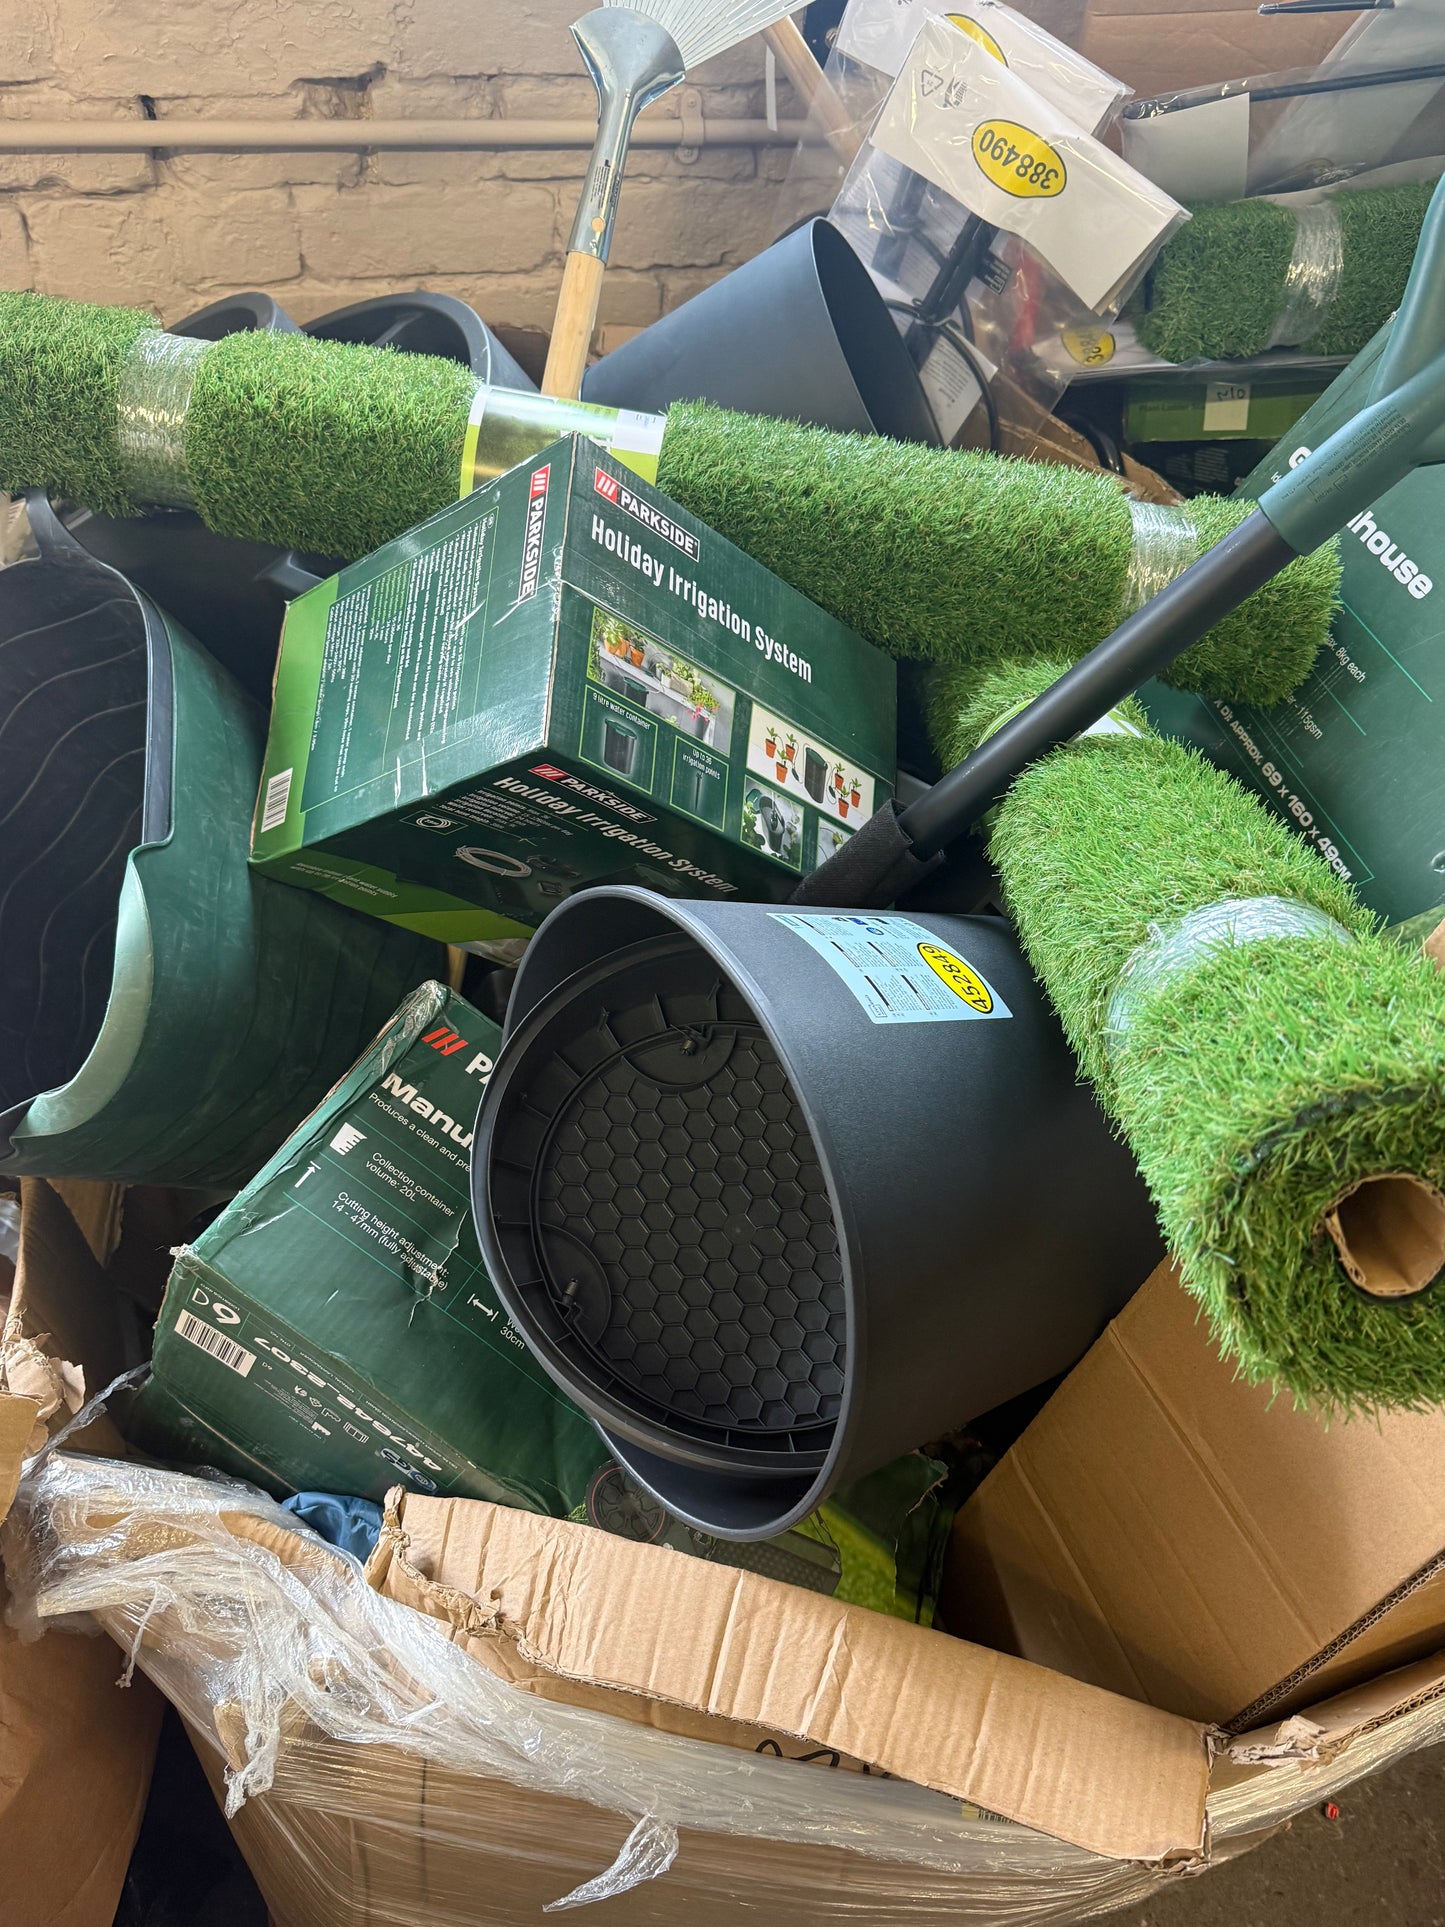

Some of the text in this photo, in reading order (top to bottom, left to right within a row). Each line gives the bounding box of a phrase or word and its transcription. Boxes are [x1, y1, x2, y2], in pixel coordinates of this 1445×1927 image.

[979, 129, 1059, 190] 388490
[521, 496, 545, 597] PARKSIDE
[620, 491, 695, 554] PARKSIDE
[592, 514, 813, 684] Holiday Irrigation System
[1335, 646, 1350, 667] 8kg
[1347, 662, 1367, 685] each
[561, 778, 643, 822] PARKSIDE
[1229, 718, 1262, 767] APPROX.
[1261, 761, 1283, 788] 69
[1287, 795, 1314, 828] 160
[493, 777, 580, 815] Holiday
[575, 811, 674, 861] Irrigation
[668, 857, 739, 893] System
[922, 945, 989, 1011] 452849
[368, 1092, 472, 1173] Produces a clean and pre
[380, 1072, 474, 1150] Manu
[365, 1160, 416, 1202] volume: 20L
[372, 1152, 455, 1218] Collection container
[331, 1200, 345, 1212] 14
[350, 1214, 380, 1239] 47mm
[377, 1234, 402, 1255] (fully
[400, 1251, 449, 1291] adjustabe)
[337, 1191, 451, 1278] Cutting height adjustment:
[499, 1325, 526, 1350] 30cm
[254, 1336, 442, 1471] 447642_2307
